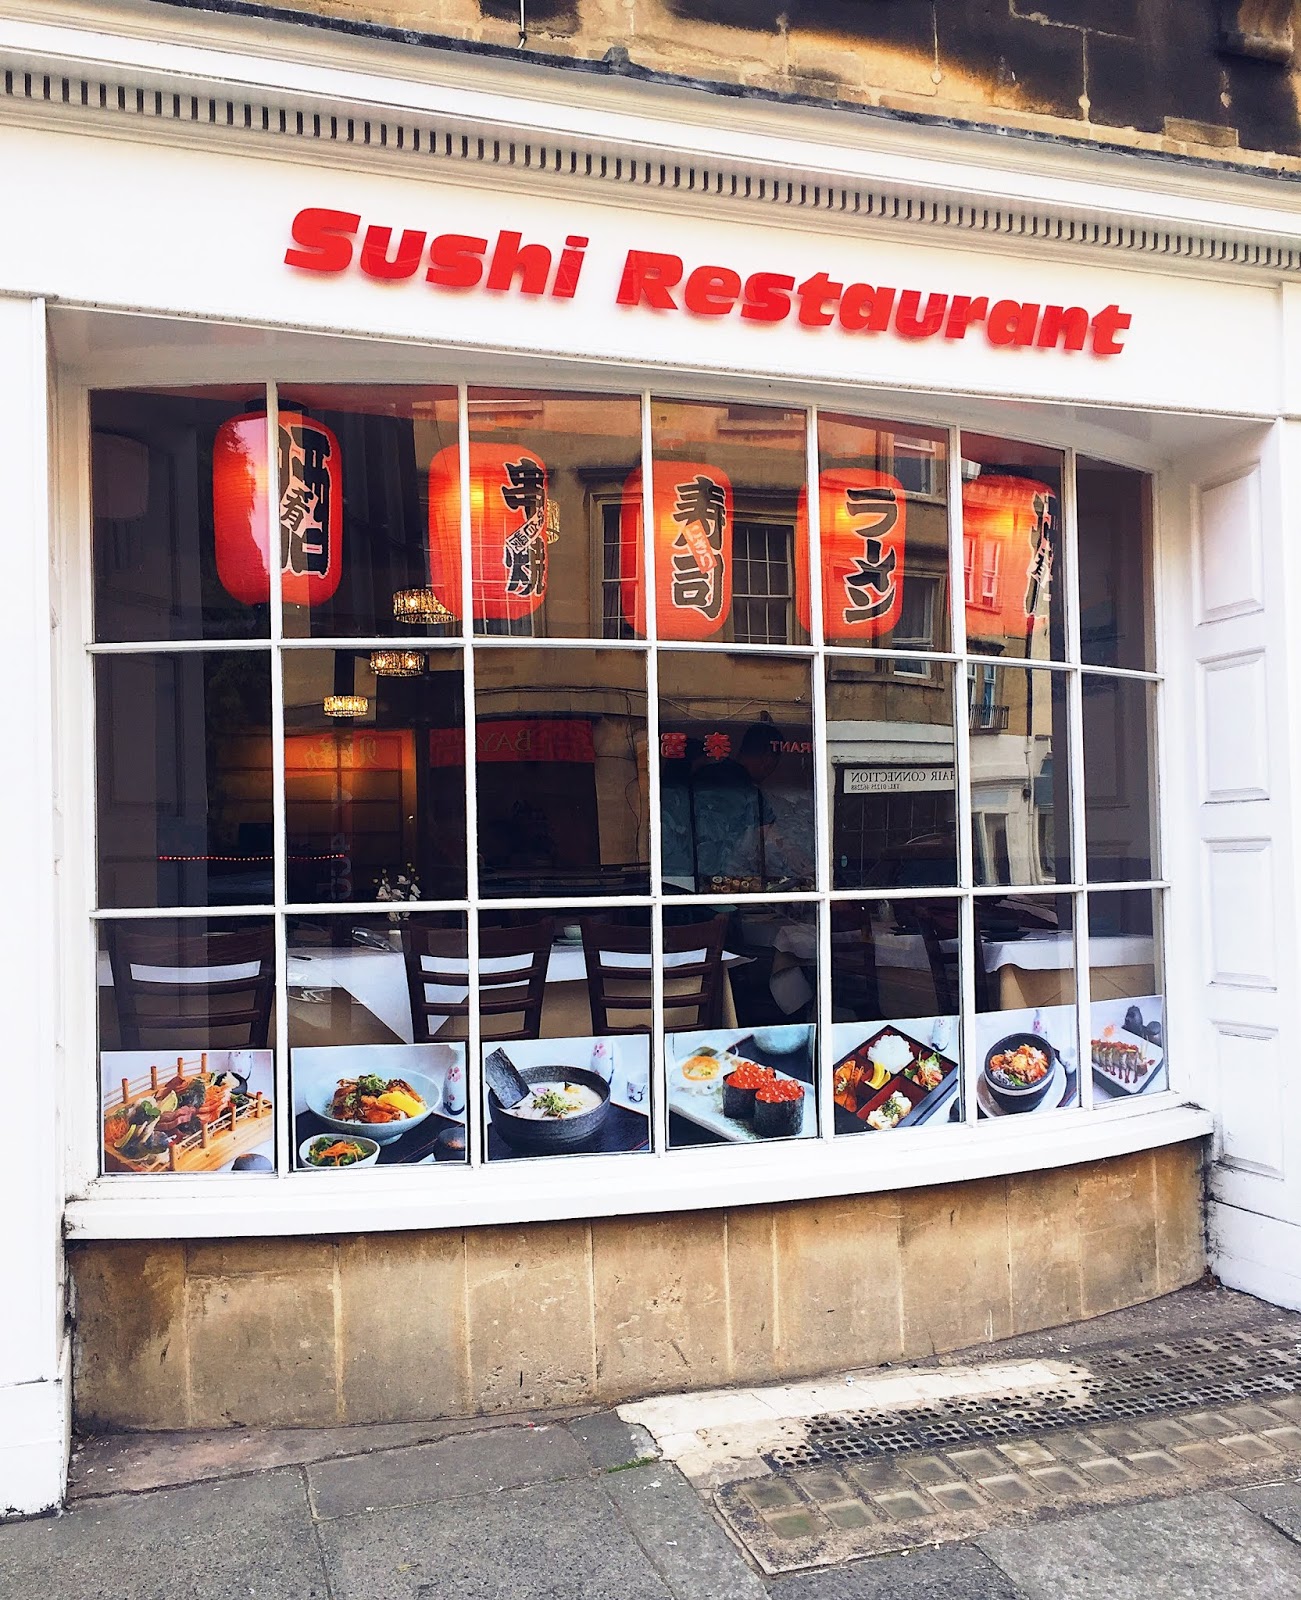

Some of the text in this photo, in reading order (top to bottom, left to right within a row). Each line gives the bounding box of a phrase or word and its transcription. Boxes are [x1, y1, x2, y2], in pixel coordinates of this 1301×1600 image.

[285, 208, 1133, 356] Sushi Restaurant
[671, 474, 727, 622] 寿司
[842, 487, 898, 626] ラーメン
